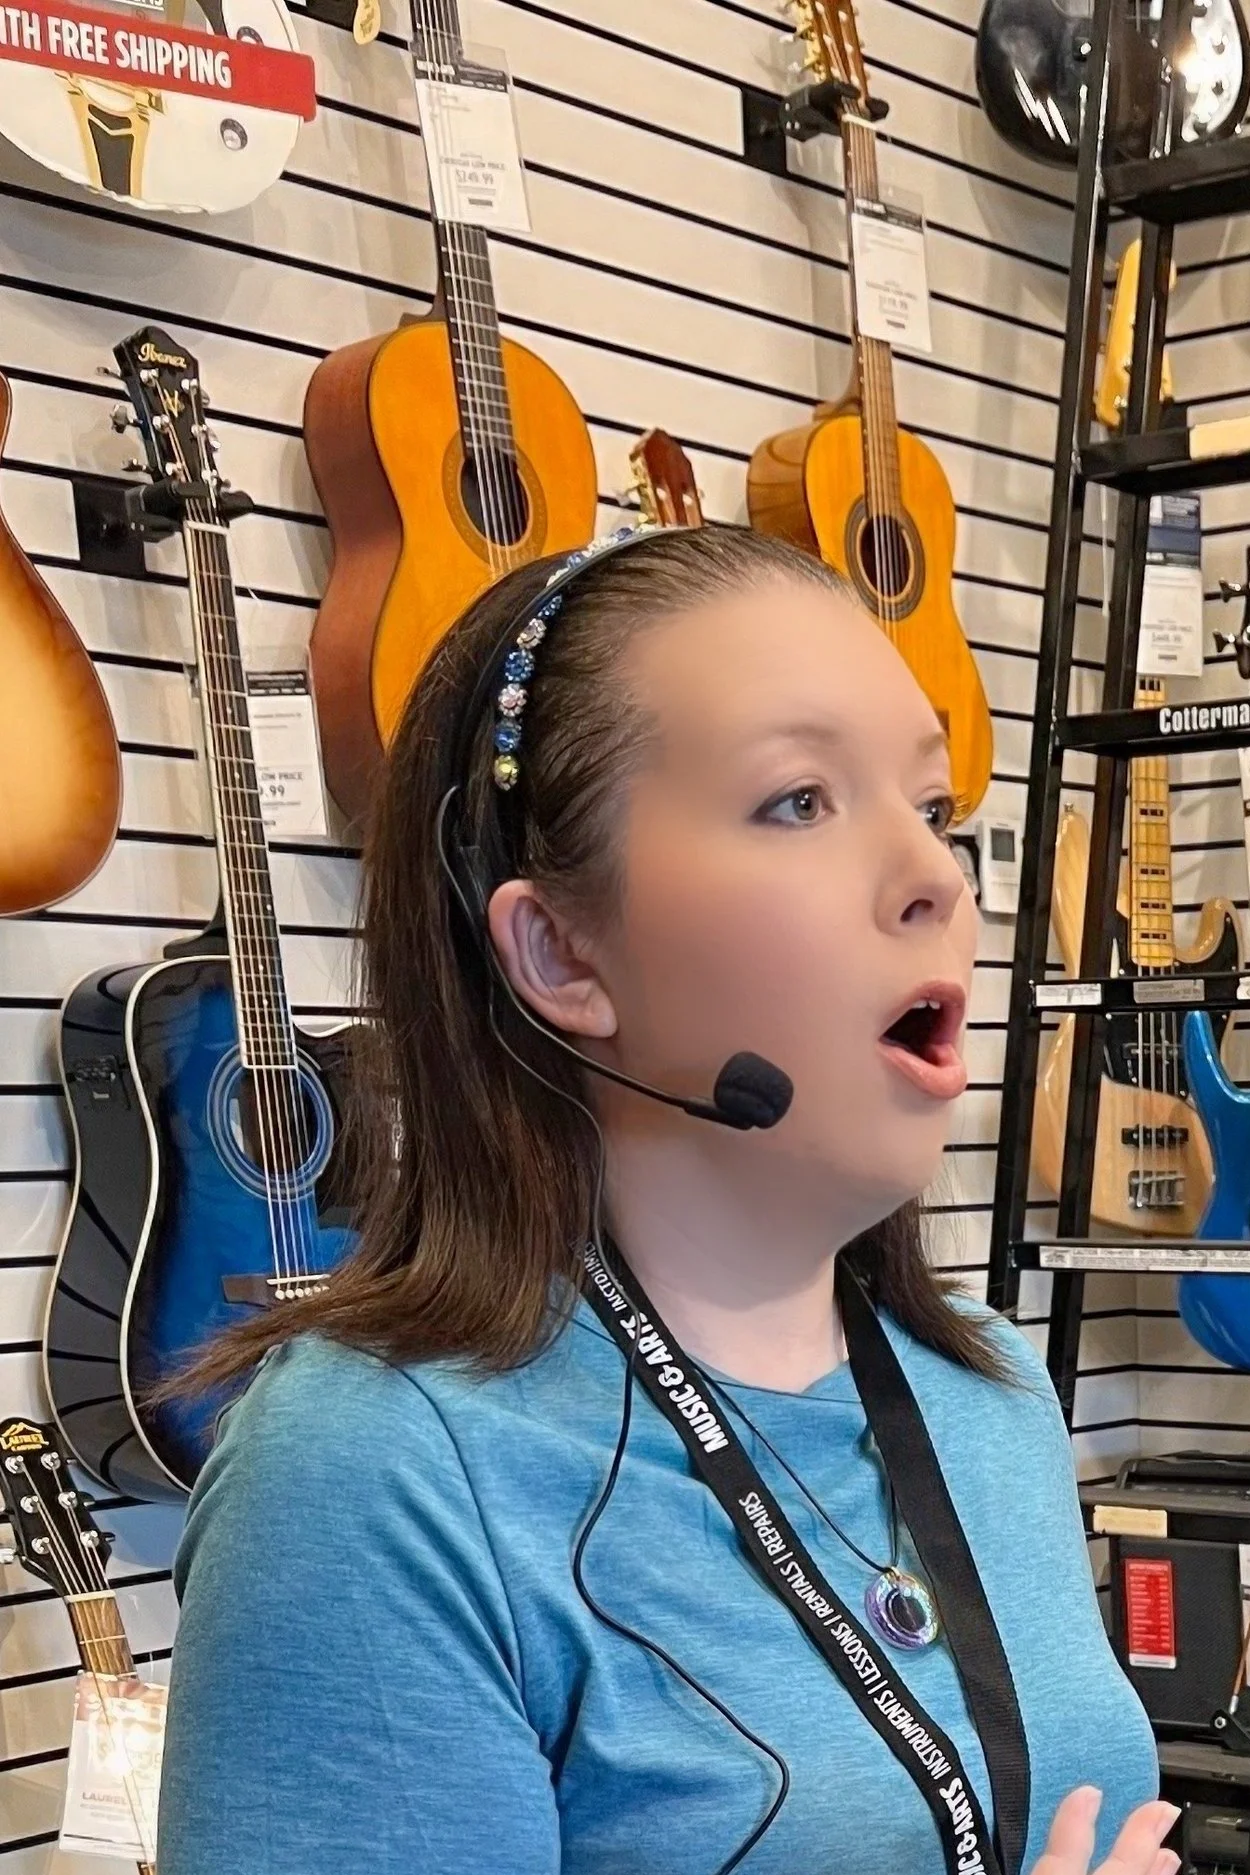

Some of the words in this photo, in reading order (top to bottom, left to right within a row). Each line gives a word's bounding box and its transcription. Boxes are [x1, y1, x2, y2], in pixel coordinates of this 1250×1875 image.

[47, 16, 109, 65] FREE
[114, 30, 232, 89] SHIPPING
[738, 1491, 786, 1557] REPAIRS
[780, 1561, 834, 1620] RENTALS
[831, 1622, 881, 1686] LESSONS
[874, 1690, 952, 1780] INSTRUMENTS
